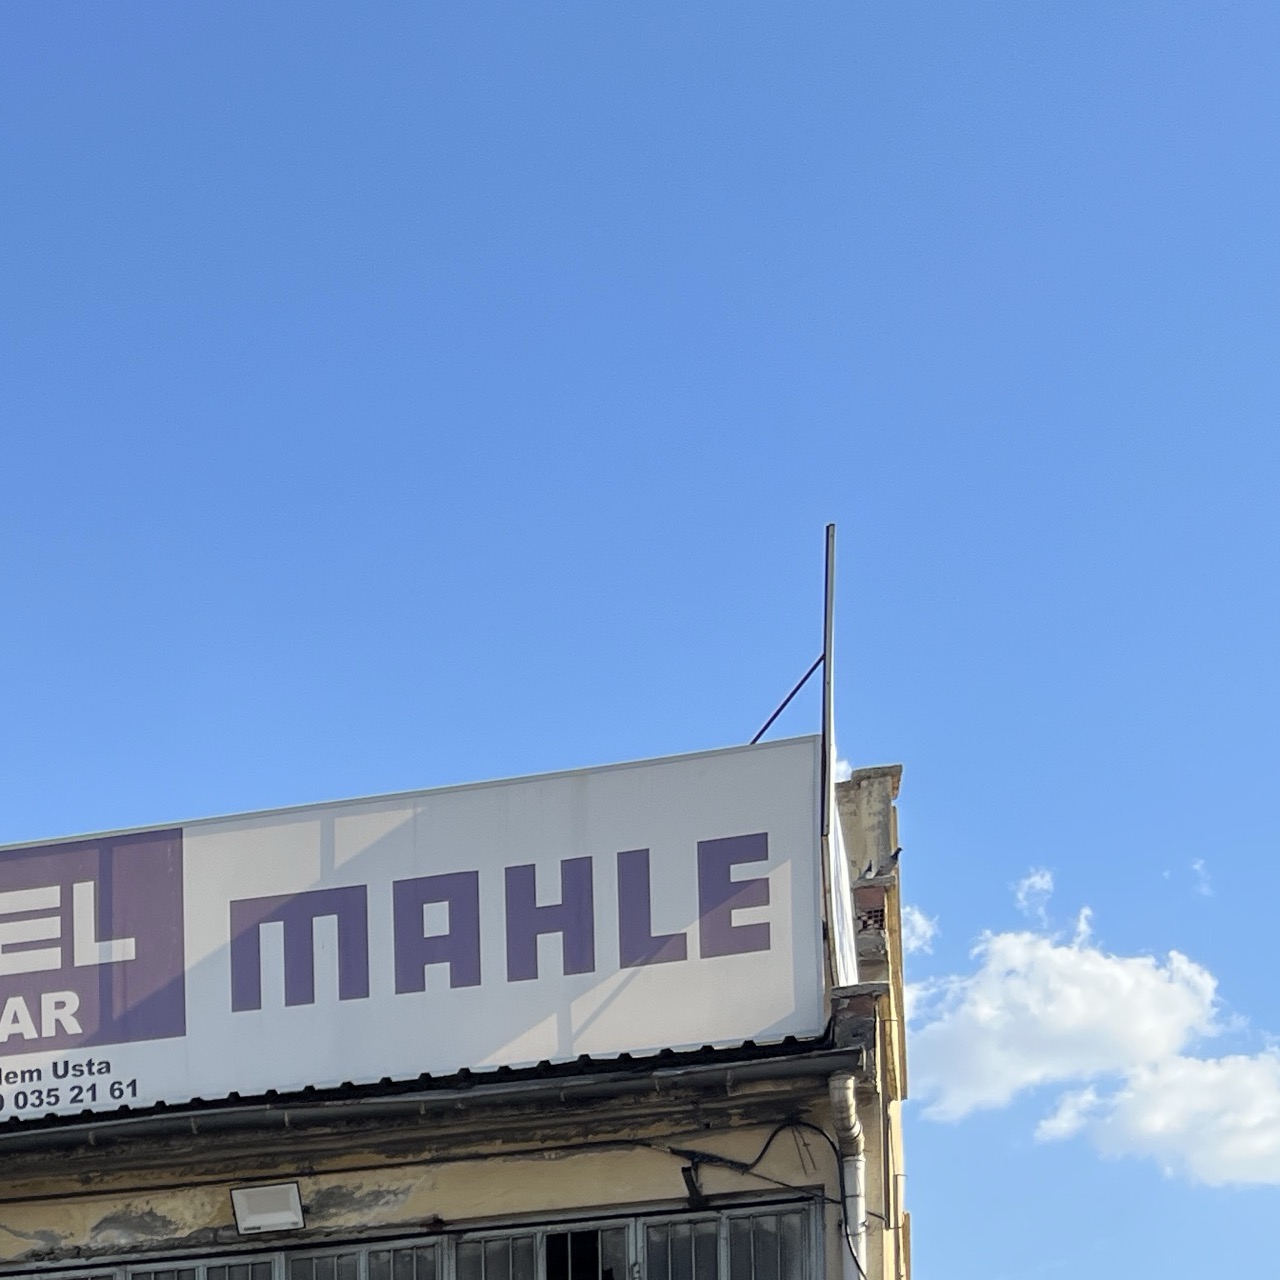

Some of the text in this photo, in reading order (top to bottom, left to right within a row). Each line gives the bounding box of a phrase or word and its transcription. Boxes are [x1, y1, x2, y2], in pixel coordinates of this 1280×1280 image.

[230, 832, 771, 1012] MAHLE
[52, 1058, 111, 1079] Usta
[14, 1088, 60, 1110] 035
[69, 1083, 97, 1104] 21
[109, 1079, 137, 1100] 61
